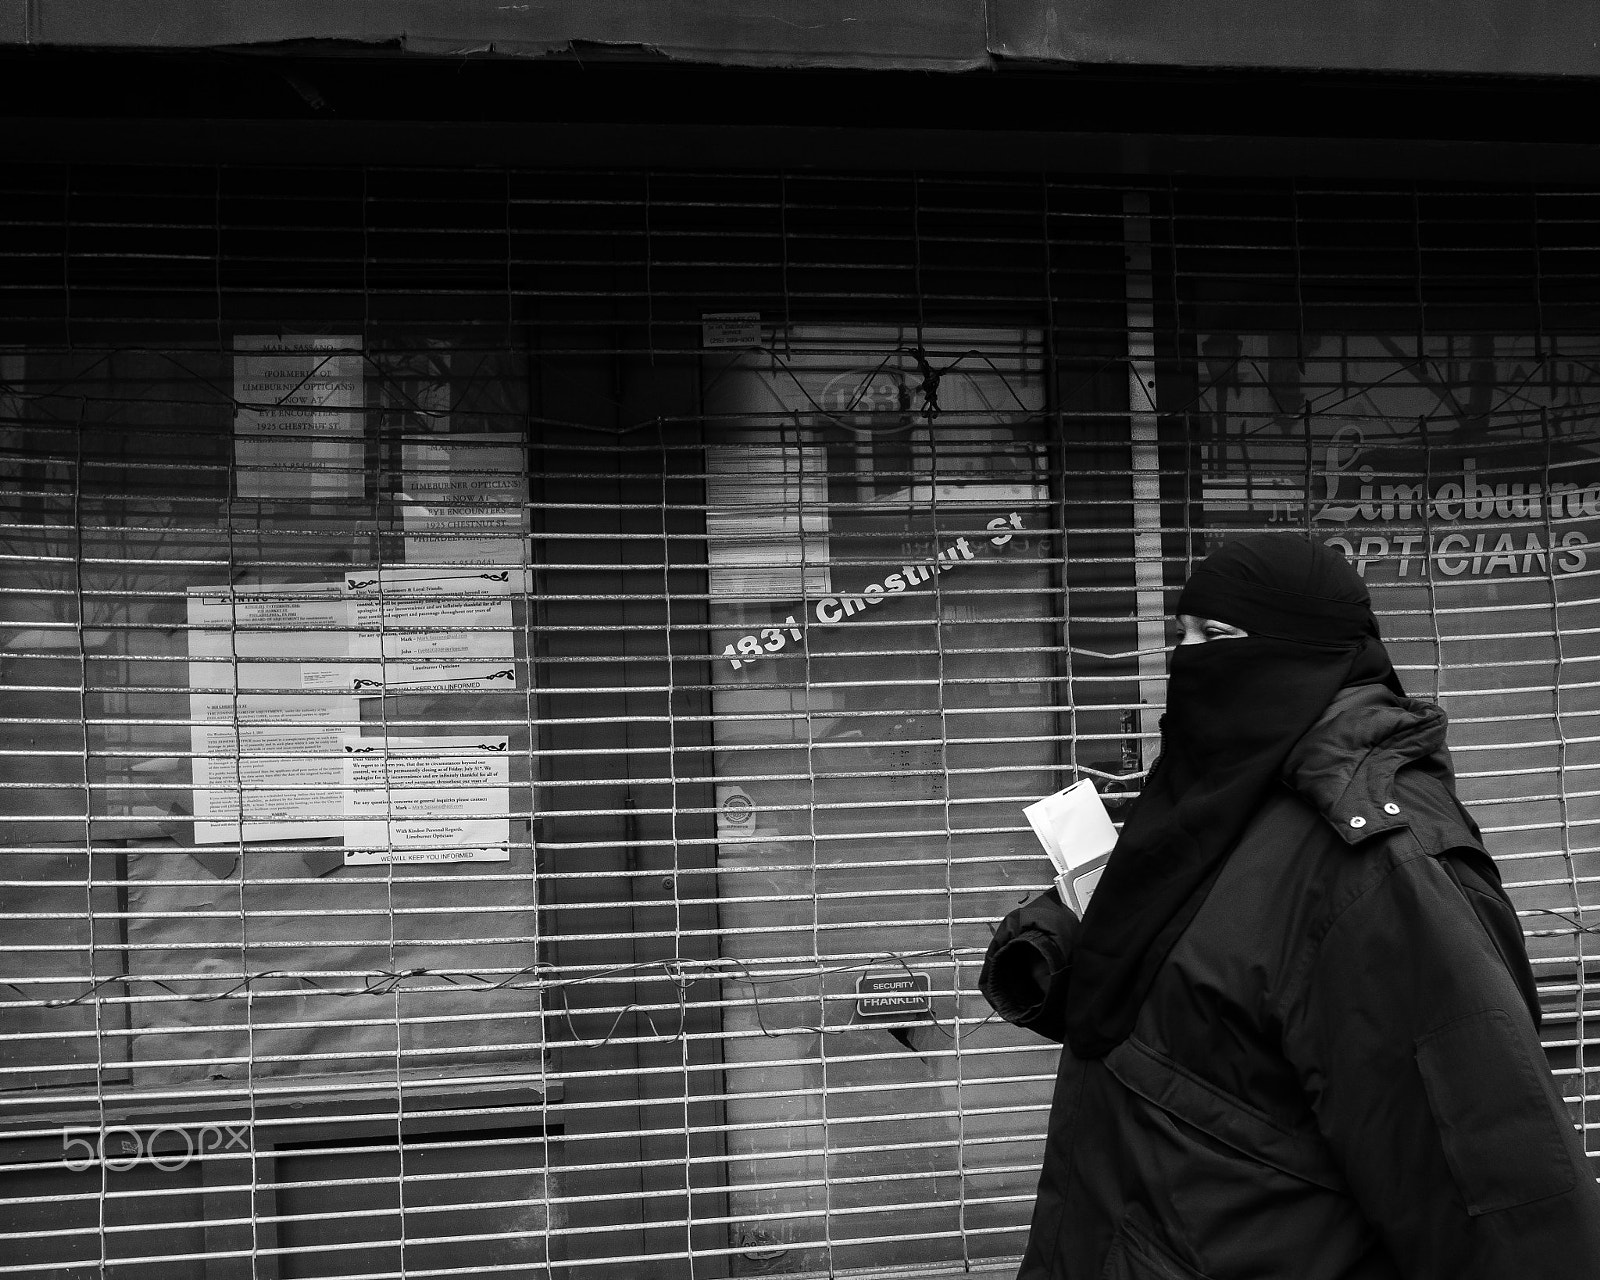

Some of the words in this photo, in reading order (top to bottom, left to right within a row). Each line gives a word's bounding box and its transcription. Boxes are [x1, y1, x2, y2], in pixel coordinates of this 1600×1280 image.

[304, 382, 355, 391] OPTICIANS)
[278, 422, 326, 430] CHESTNUT
[411, 482, 468, 490] LIMEBURNER
[470, 480, 521, 489] OPTICIANS)
[447, 520, 494, 528] CHESTNUT
[722, 615, 803, 670] 1831
[816, 537, 974, 623] Chestnut
[986, 512, 1026, 546] St
[872, 981, 914, 990] SECURITY
[864, 996, 925, 1007] FRANKLIN
